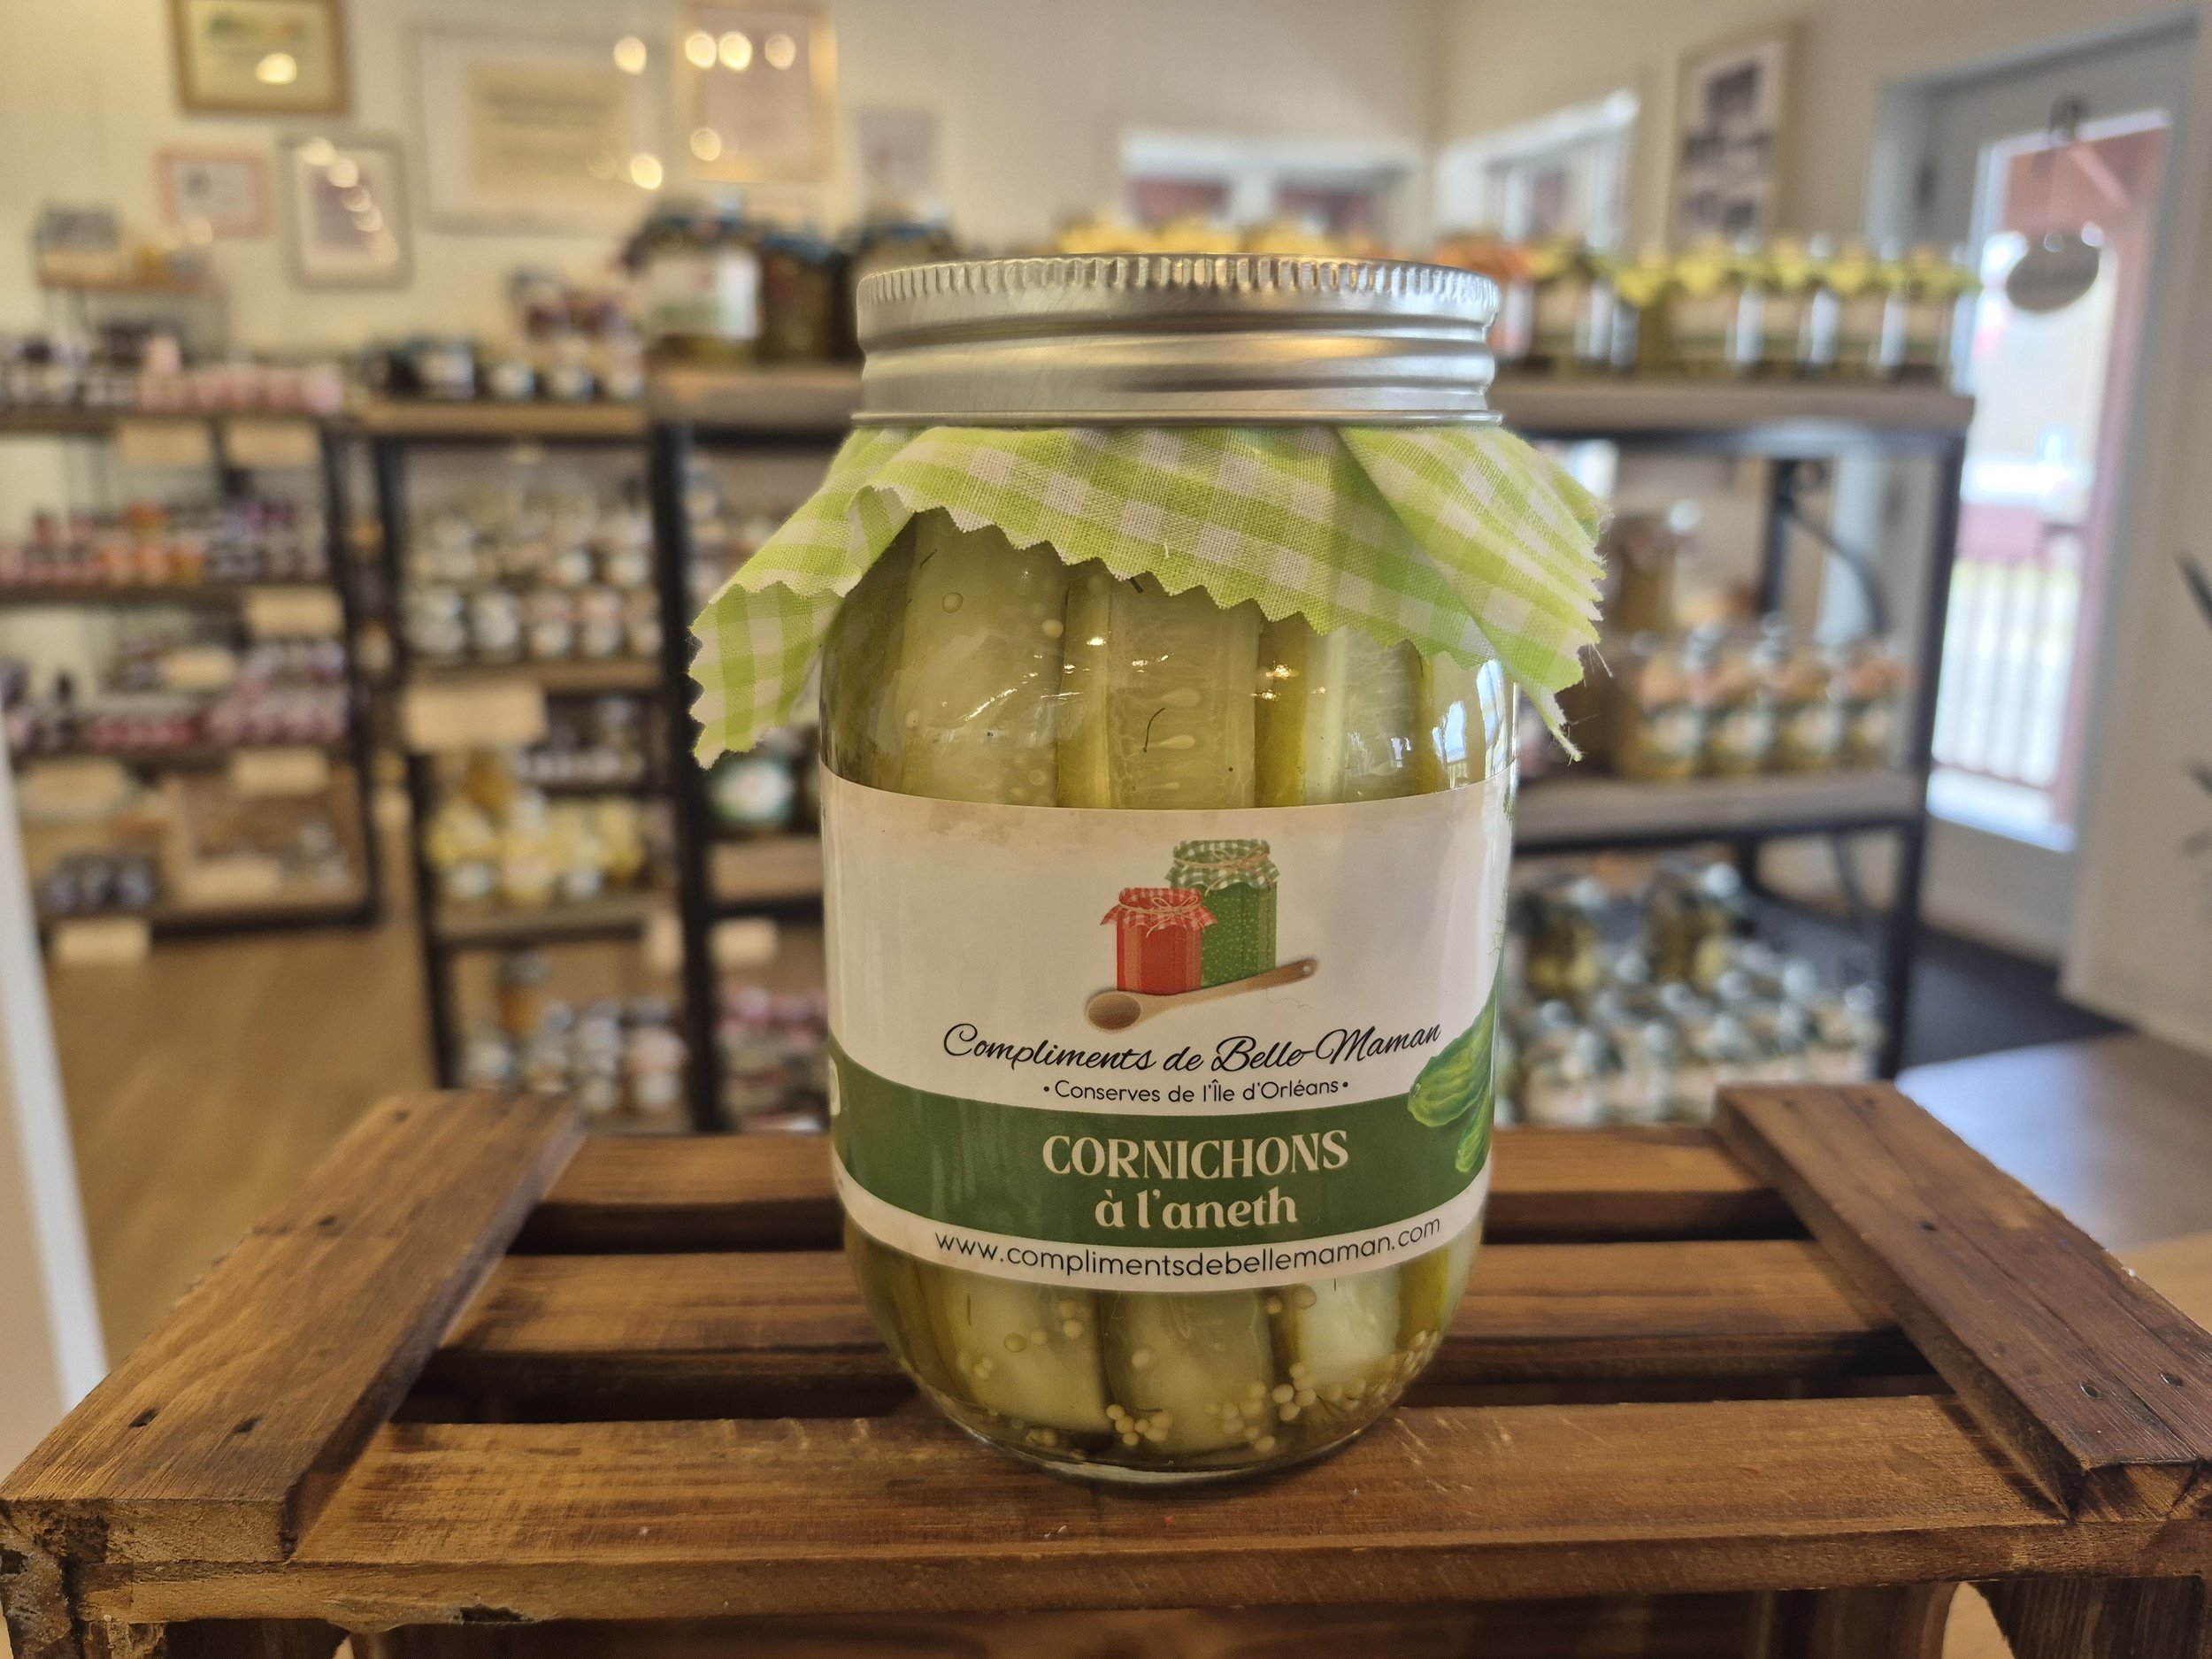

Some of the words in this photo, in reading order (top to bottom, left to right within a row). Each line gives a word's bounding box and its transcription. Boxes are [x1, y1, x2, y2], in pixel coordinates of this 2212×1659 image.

[943, 1023, 1157, 1071] Compliments
[1163, 1046, 1204, 1072] de
[1210, 1023, 1441, 1072] Belle-Maman
[1054, 1079, 1161, 1102] Conserves
[1168, 1085, 1194, 1102] de
[1202, 1079, 1235, 1102] l'Île
[1242, 1079, 1339, 1101] d'Orléans
[1042, 1130, 1349, 1179] CORNICHONS
[1094, 1188, 1125, 1228] à
[1138, 1187, 1299, 1229] l'aneth
[934, 1217, 1441, 1277] www.complimentsdebellemaman.com
